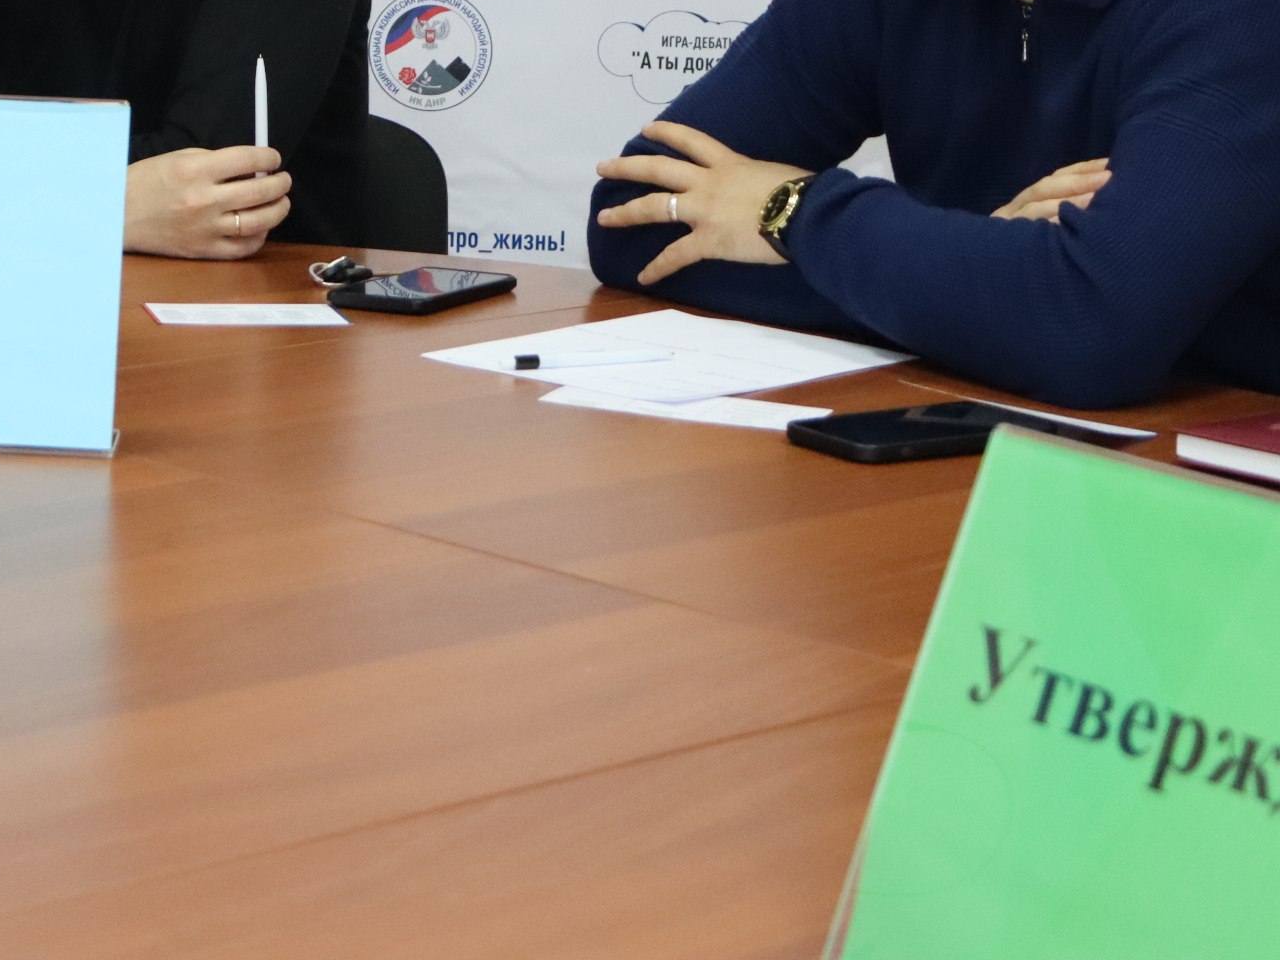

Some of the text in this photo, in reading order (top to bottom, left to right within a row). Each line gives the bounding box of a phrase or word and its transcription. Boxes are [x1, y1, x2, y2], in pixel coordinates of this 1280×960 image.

[461, 7, 489, 48] НАРОДНОЙ
[374, 29, 400, 95] ИЗБИРАТЕЛЬНАЯ
[458, 49, 487, 96] РЕСПУБЛИКИ
[657, 56, 678, 70] ты
[409, 95, 446, 107] ИК ДНР
[967, 622, 1280, 817] Утверж
